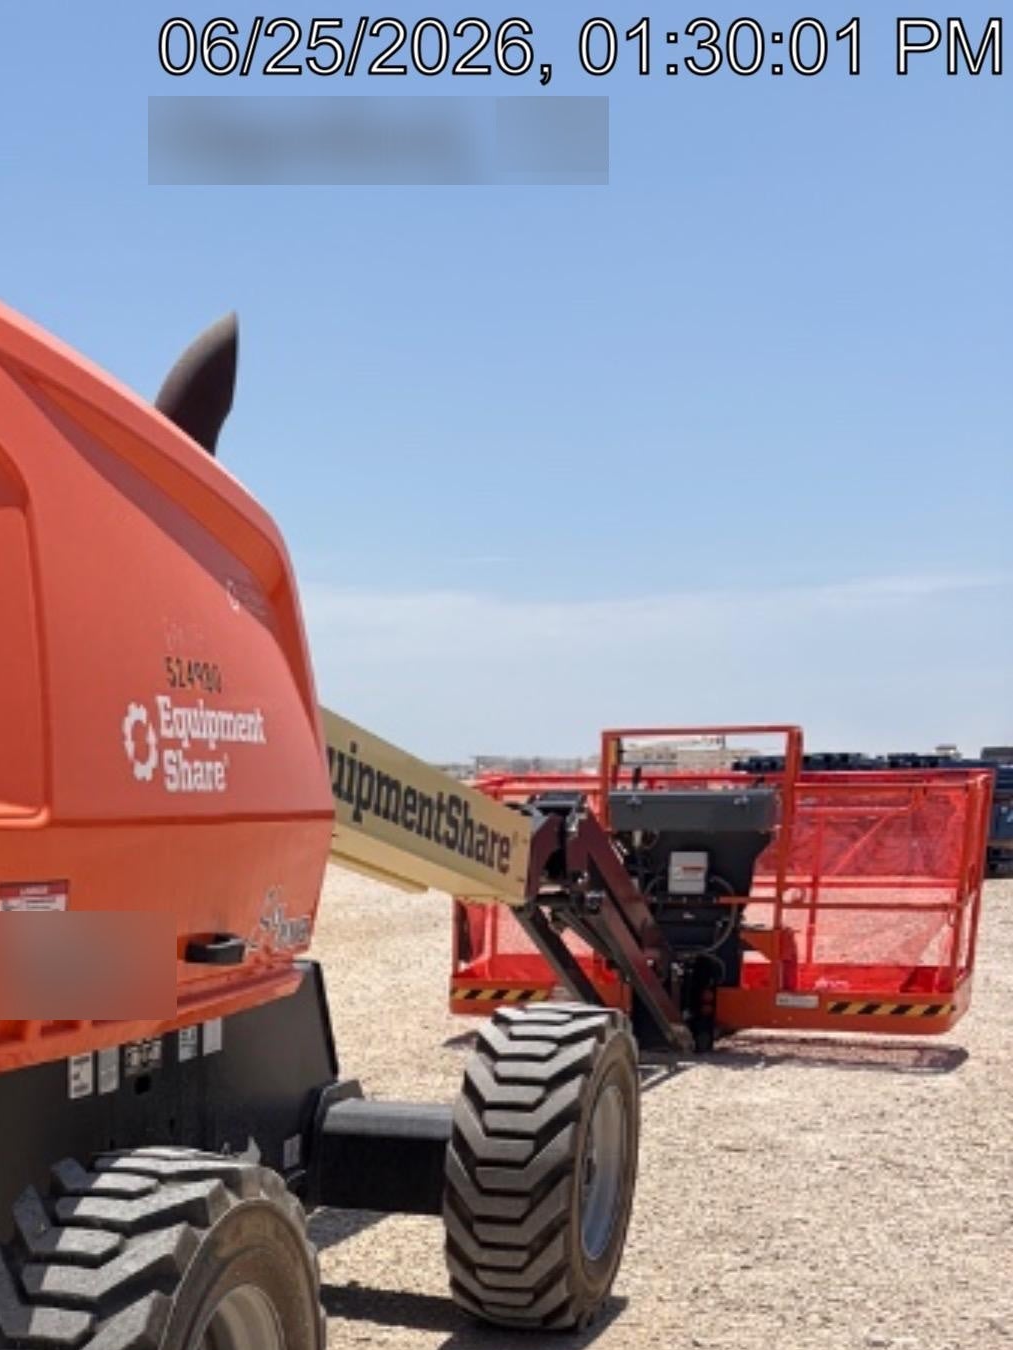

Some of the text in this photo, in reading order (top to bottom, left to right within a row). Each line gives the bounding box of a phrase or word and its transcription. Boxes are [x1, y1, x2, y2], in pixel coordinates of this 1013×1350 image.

[164, 655, 223, 694] 524980
[156, 695, 267, 750] Equipment
[163, 749, 227, 793] Share
